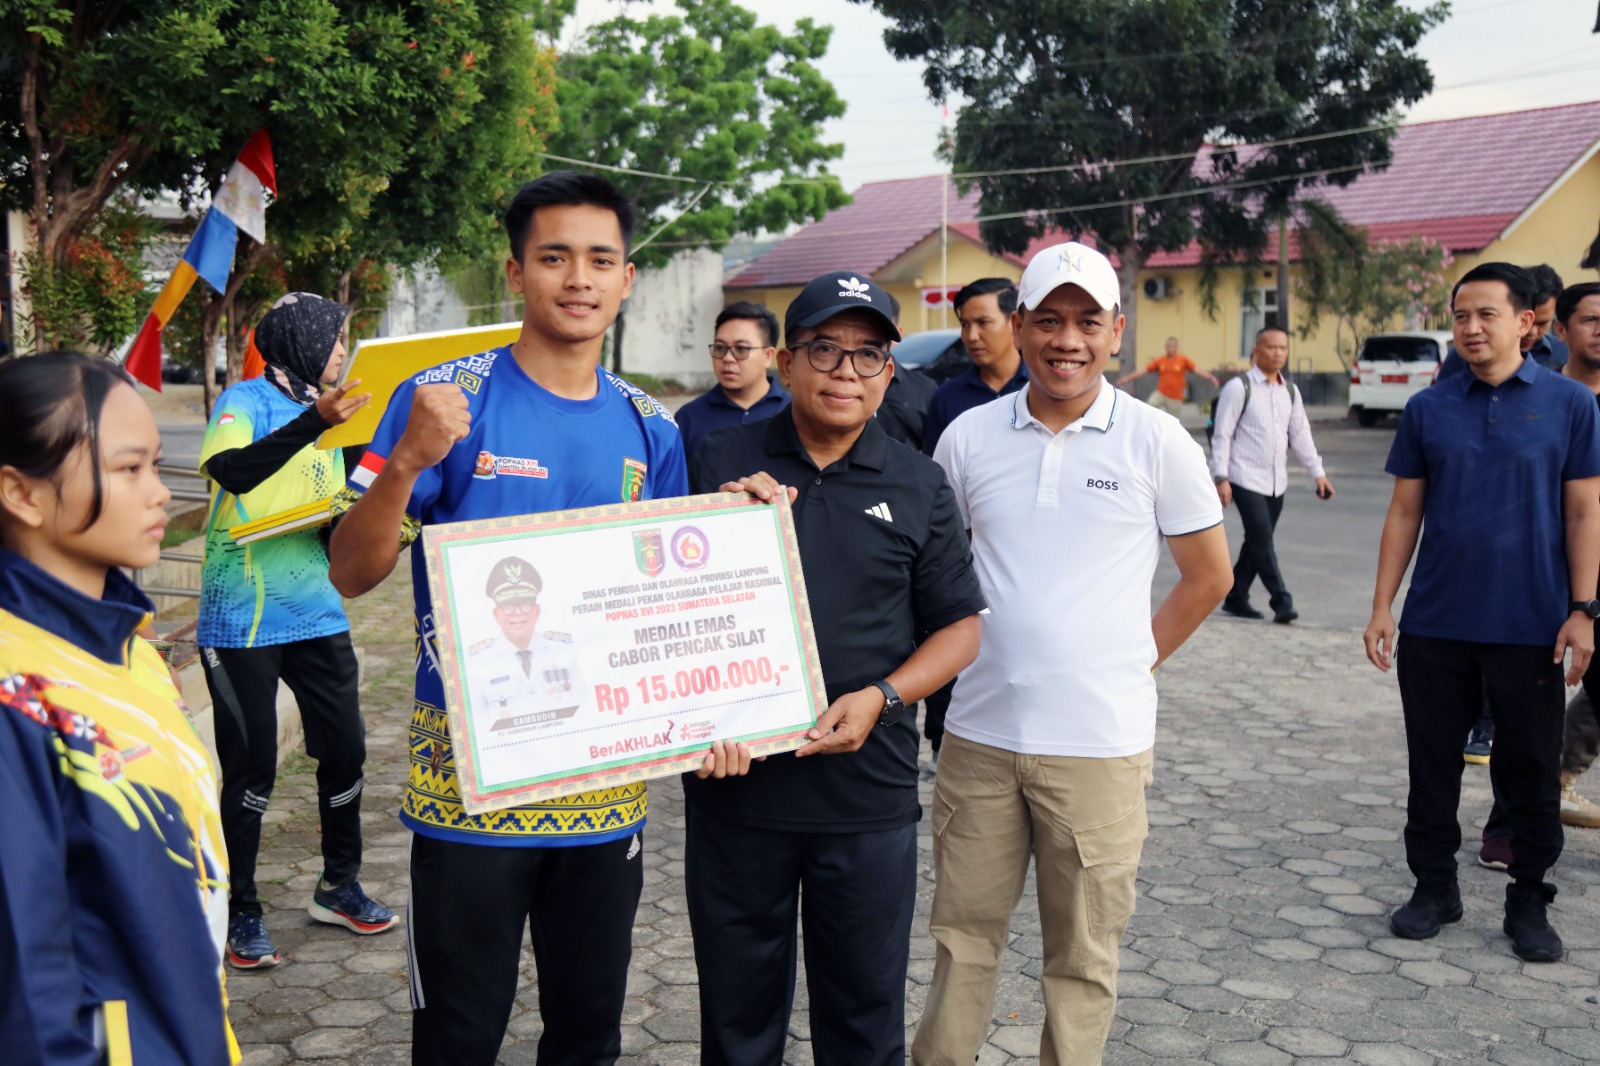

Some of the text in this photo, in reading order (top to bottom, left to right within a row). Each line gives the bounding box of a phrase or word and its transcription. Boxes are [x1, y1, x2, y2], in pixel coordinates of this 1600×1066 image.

[838, 290, 872, 302] adidas
[498, 458, 525, 466] POPNAS
[1086, 478, 1119, 491] BOSS
[572, 576, 782, 615] PERAIH MEDALI PEKAN OLAHRAGA PELAJAR NASIONAL
[582, 565, 769, 600] DINAS PEMUDA DAN OLAHRAGA PROVINSI LAMPUNG
[605, 591, 756, 622] POPNAS XVI 2023 SUMATERA SELATAN
[633, 614, 737, 645] MEDALI EMAS
[608, 628, 766, 668] CABOR PENCAK SILAT
[594, 656, 790, 715] Rp 15.000.000,-
[513, 711, 557, 726] SAMSUDIN
[589, 730, 672, 759] BerAKHLAK
